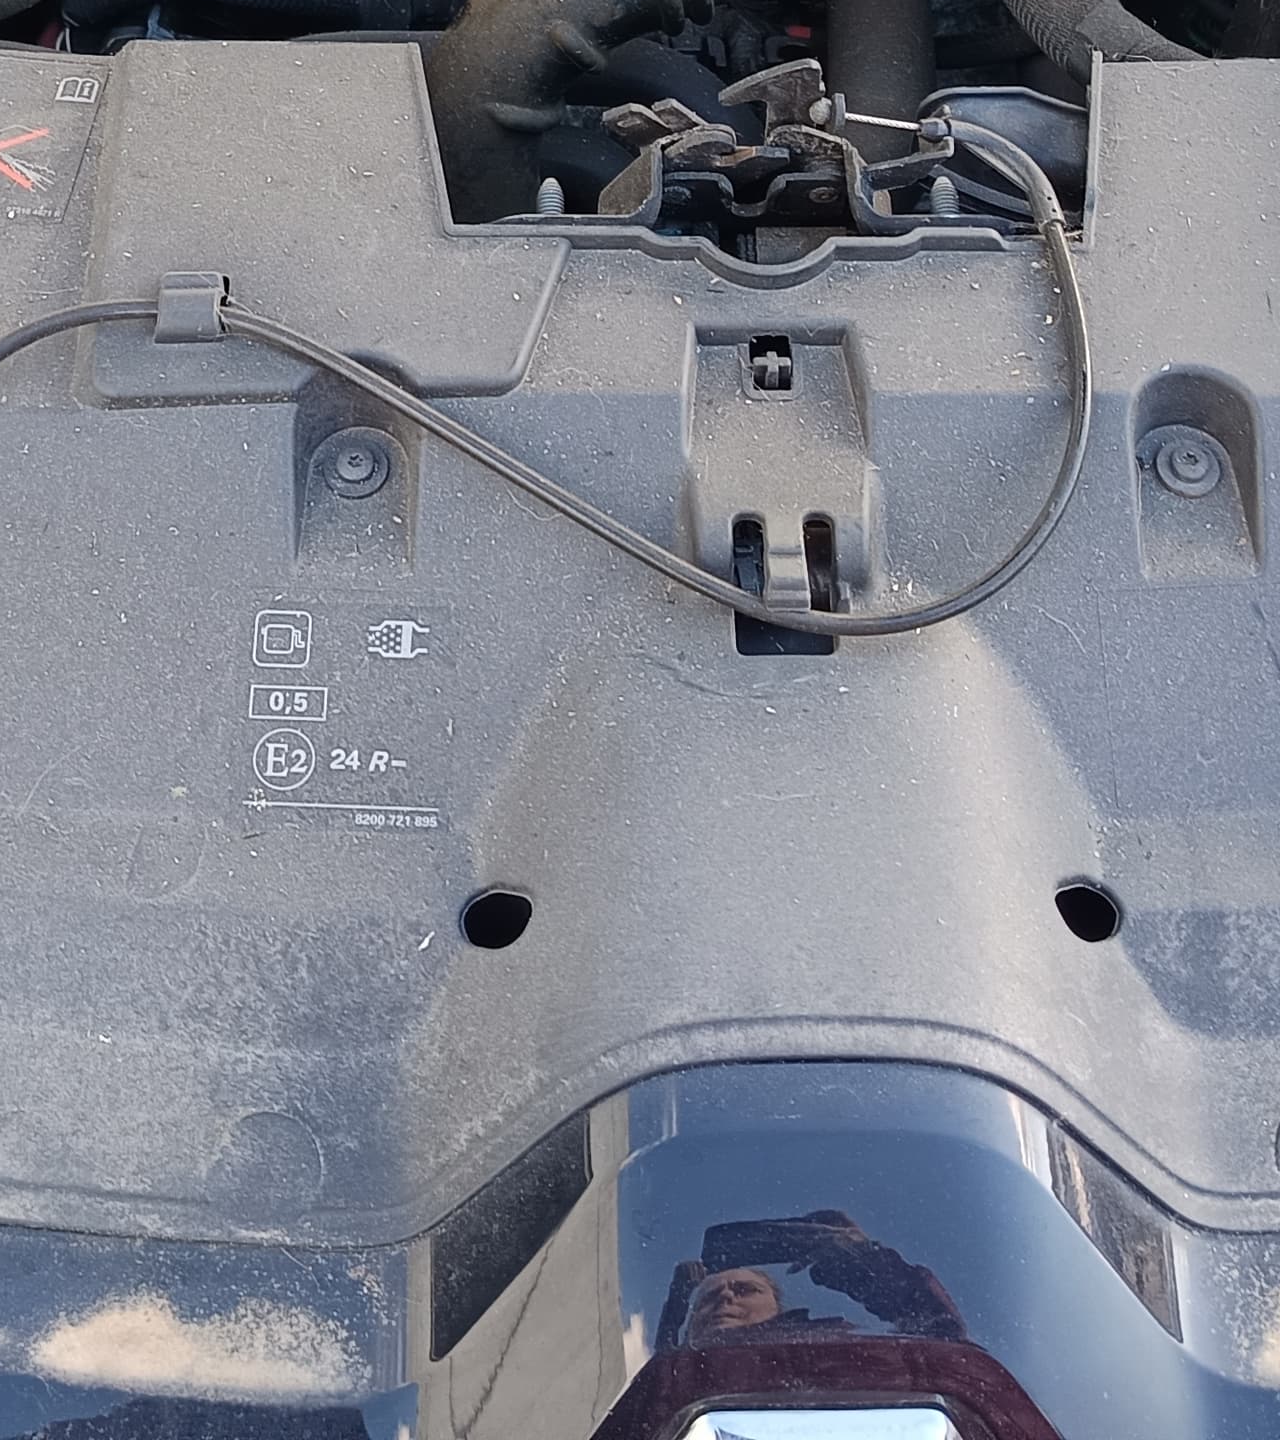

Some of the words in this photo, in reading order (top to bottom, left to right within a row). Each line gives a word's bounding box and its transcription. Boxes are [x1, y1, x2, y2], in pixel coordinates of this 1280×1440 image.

[269, 692, 308, 715] 0,5
[263, 742, 308, 777] E2
[330, 749, 361, 770] 24
[355, 813, 385, 825] 8200
[388, 814, 411, 828] 721
[414, 815, 438, 828] 895
